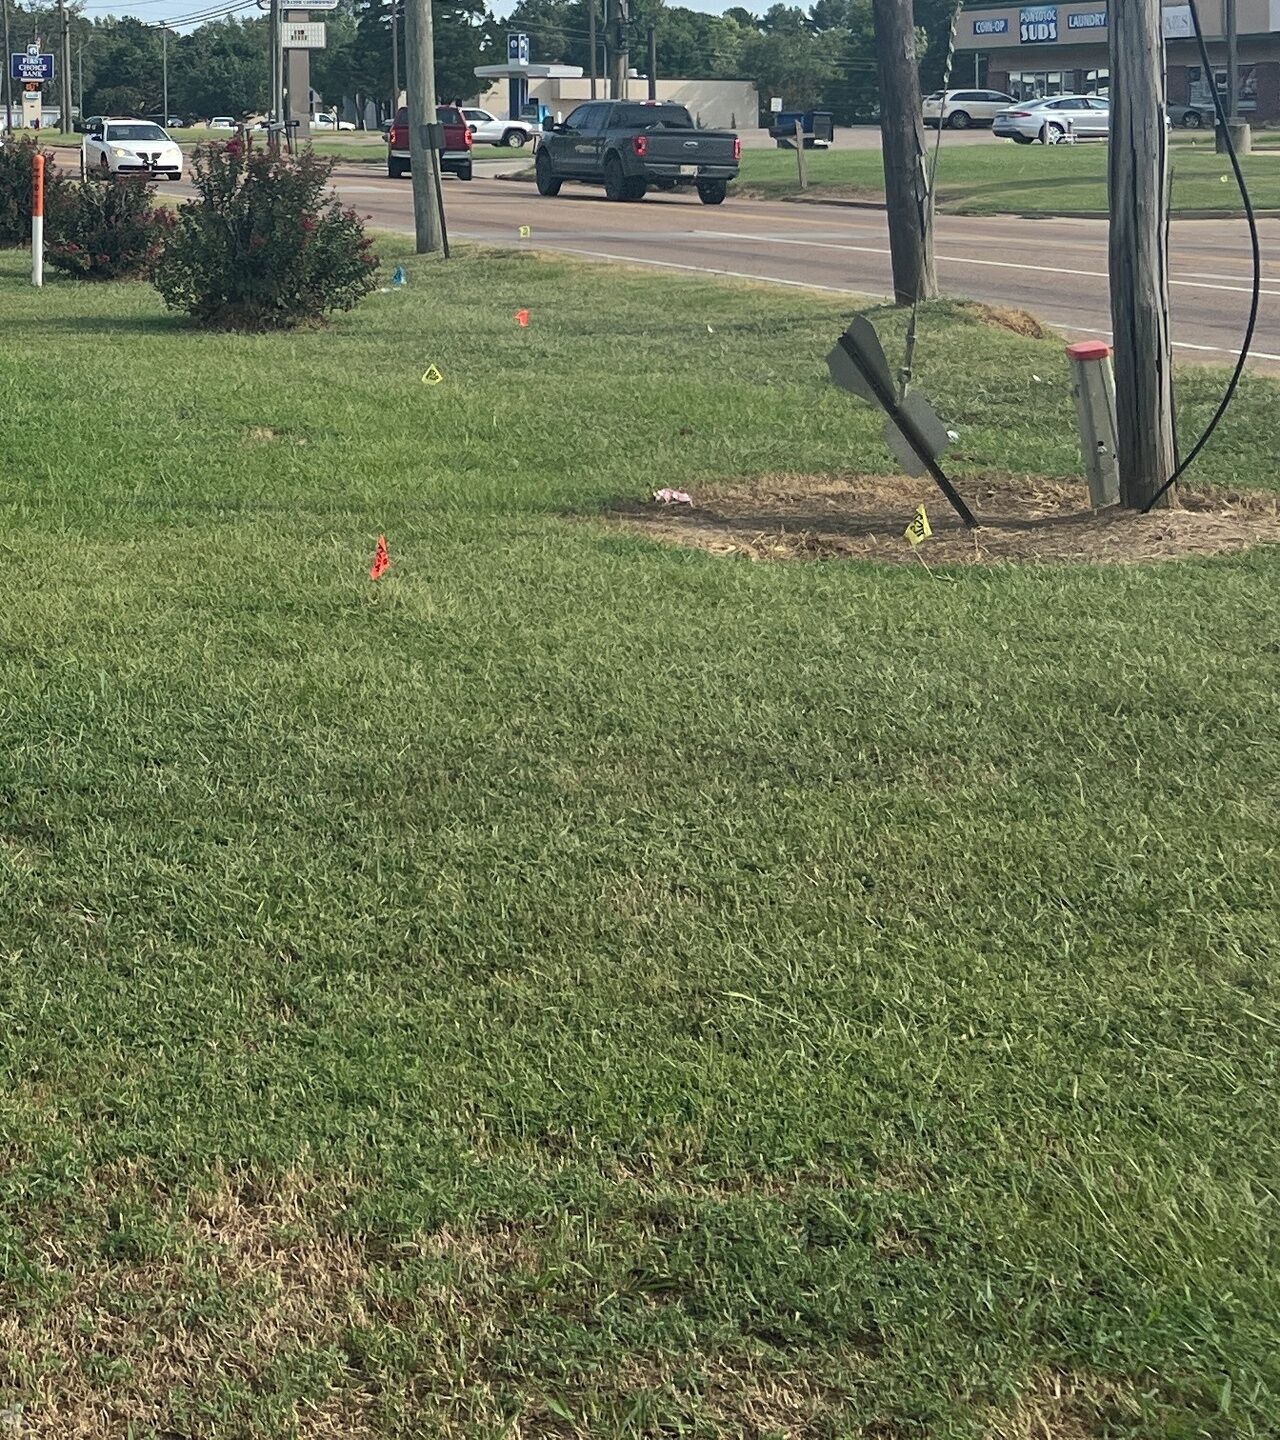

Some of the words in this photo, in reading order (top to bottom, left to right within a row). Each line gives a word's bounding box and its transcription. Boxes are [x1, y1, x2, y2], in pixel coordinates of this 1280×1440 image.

[975, 20, 1005, 34] COIN-OP
[1068, 13, 1106, 28] LAUNDRY
[1020, 23, 1057, 41] SUDS
